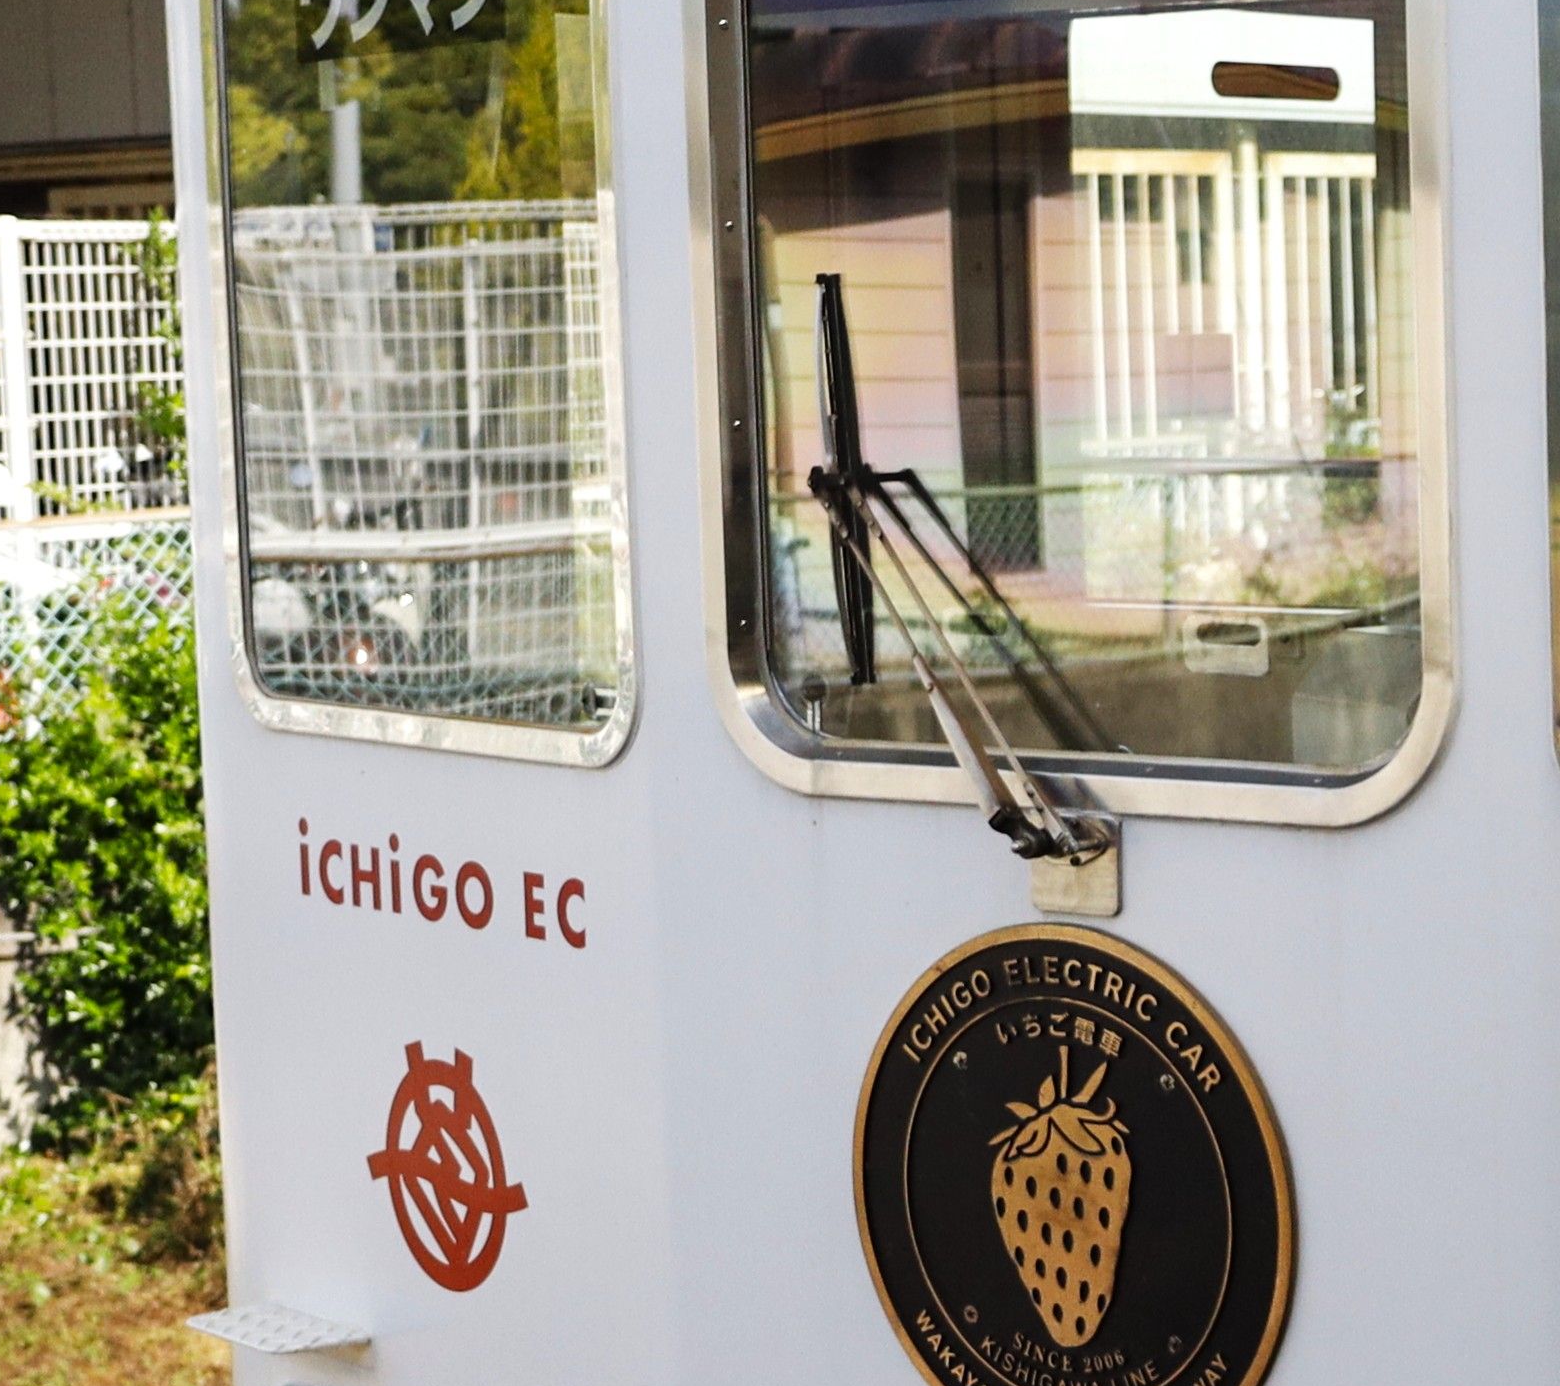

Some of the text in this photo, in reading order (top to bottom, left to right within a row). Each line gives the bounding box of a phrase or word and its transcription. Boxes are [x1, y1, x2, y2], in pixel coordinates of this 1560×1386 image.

[523, 872, 586, 949] EC
[903, 956, 1223, 1095] ICHIGO ELECTRIC CAR
[995, 1012, 1124, 1057] いちご電車
[1012, 1331, 1125, 1373] SINCE 2006
